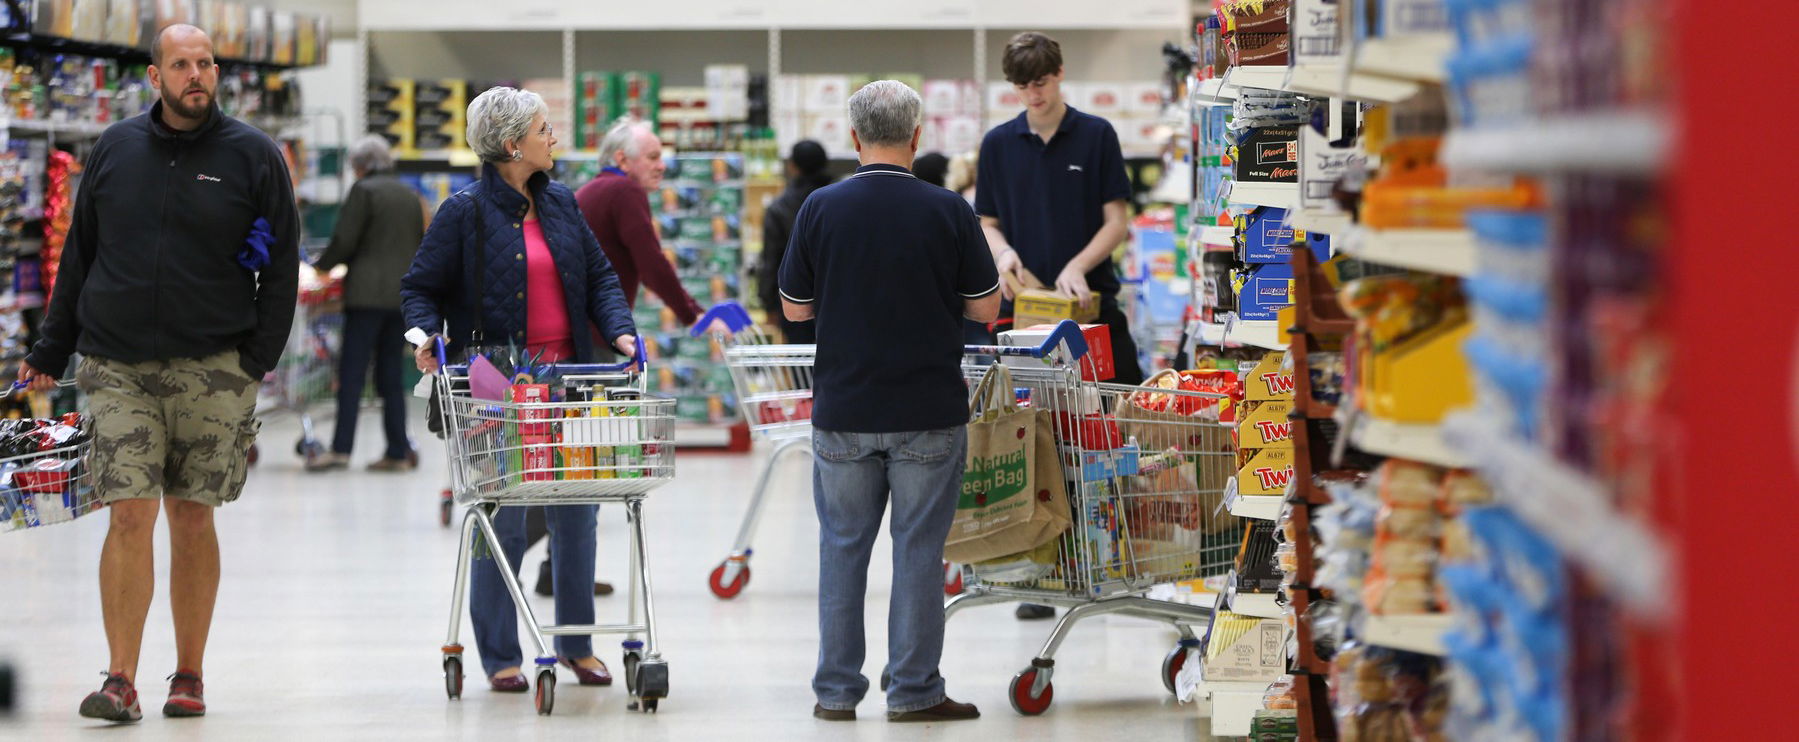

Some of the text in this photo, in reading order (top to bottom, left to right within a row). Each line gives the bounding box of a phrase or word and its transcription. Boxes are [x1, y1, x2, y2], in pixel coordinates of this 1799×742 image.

[1261, 148, 1286, 158] Mars
[973, 443, 1026, 473] Natural
[995, 467, 1024, 490] Bag
